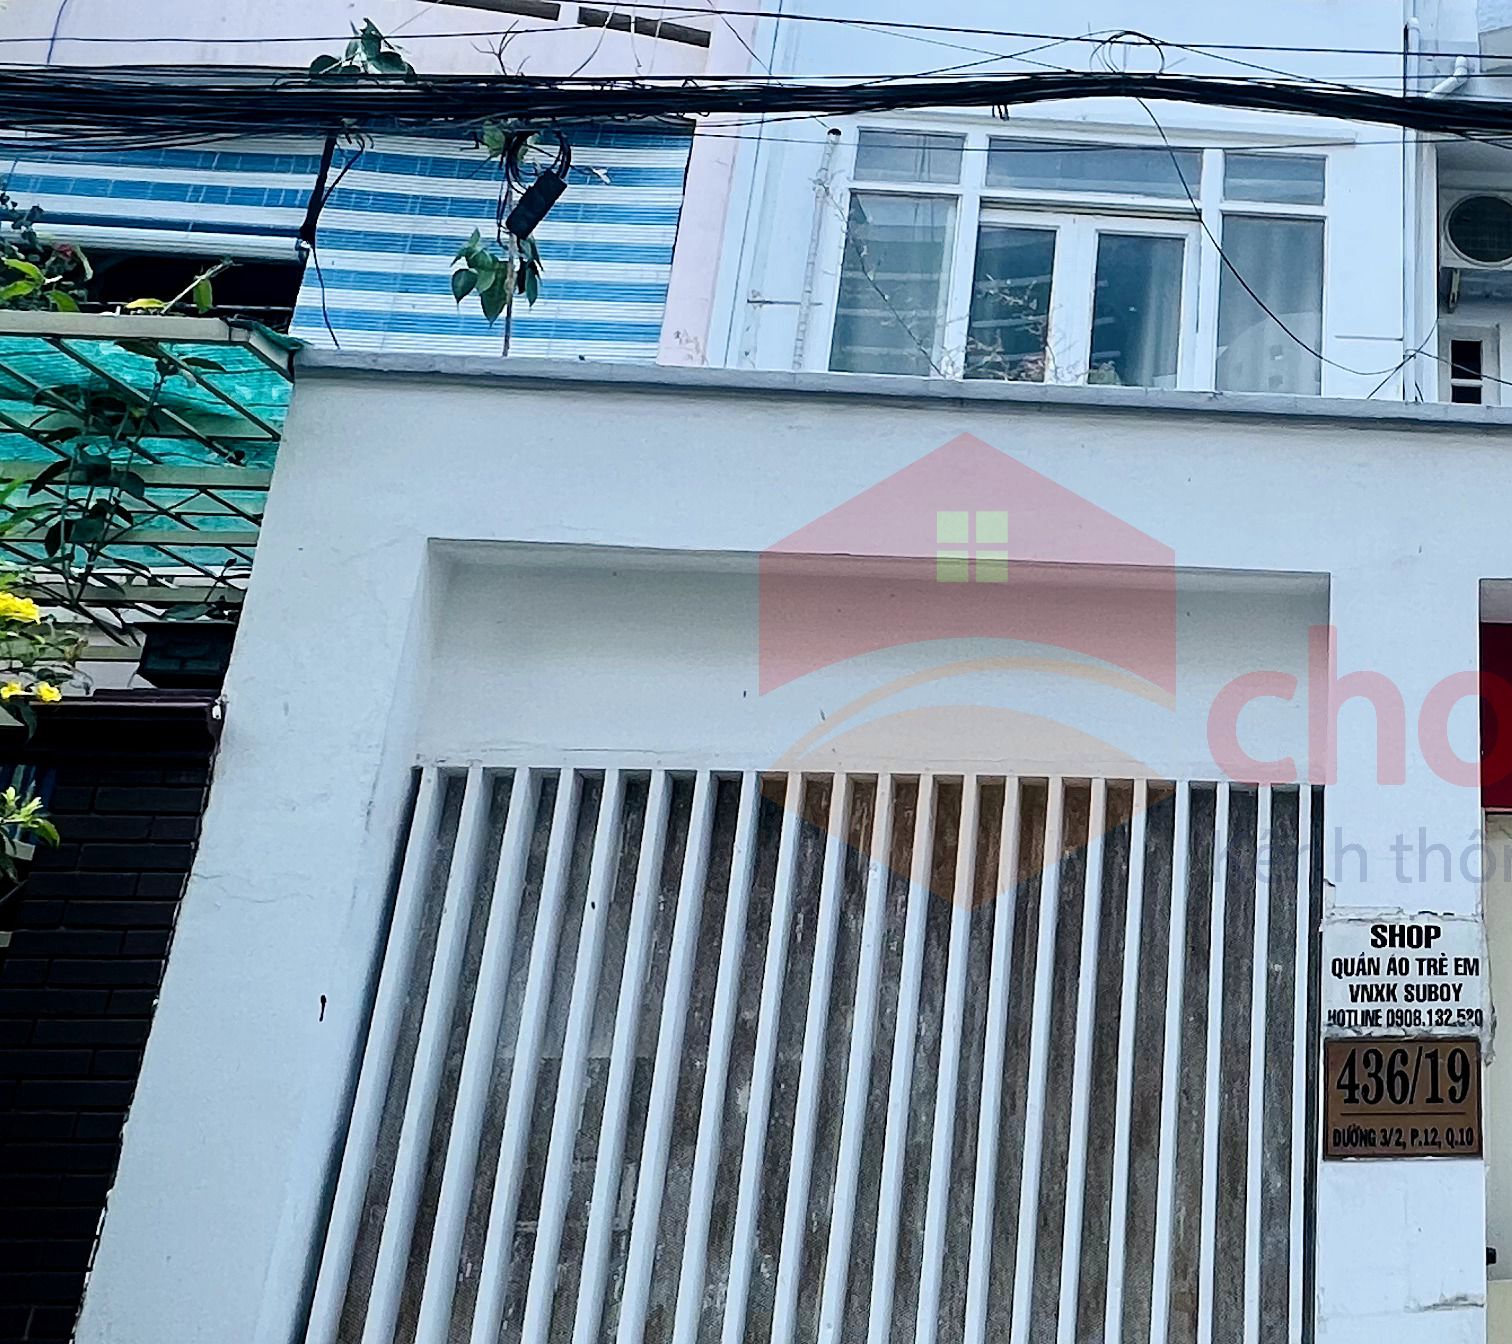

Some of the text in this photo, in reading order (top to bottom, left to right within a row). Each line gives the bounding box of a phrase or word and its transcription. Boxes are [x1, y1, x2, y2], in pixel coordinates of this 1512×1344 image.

[1371, 925, 1441, 948] SHOP
[1387, 954, 1410, 976] ÁO
[1454, 957, 1480, 976] EM
[1349, 983, 1463, 1002] VNXK SUBOY
[1328, 1009, 1483, 1027] HOTLINE 0908.132.520
[1336, 1046, 1470, 1105] 436/19
[1380, 1127, 1406, 1150] 3/2,
[1411, 1127, 1442, 1149] P.12,
[1445, 1127, 1474, 1149] Q.10
